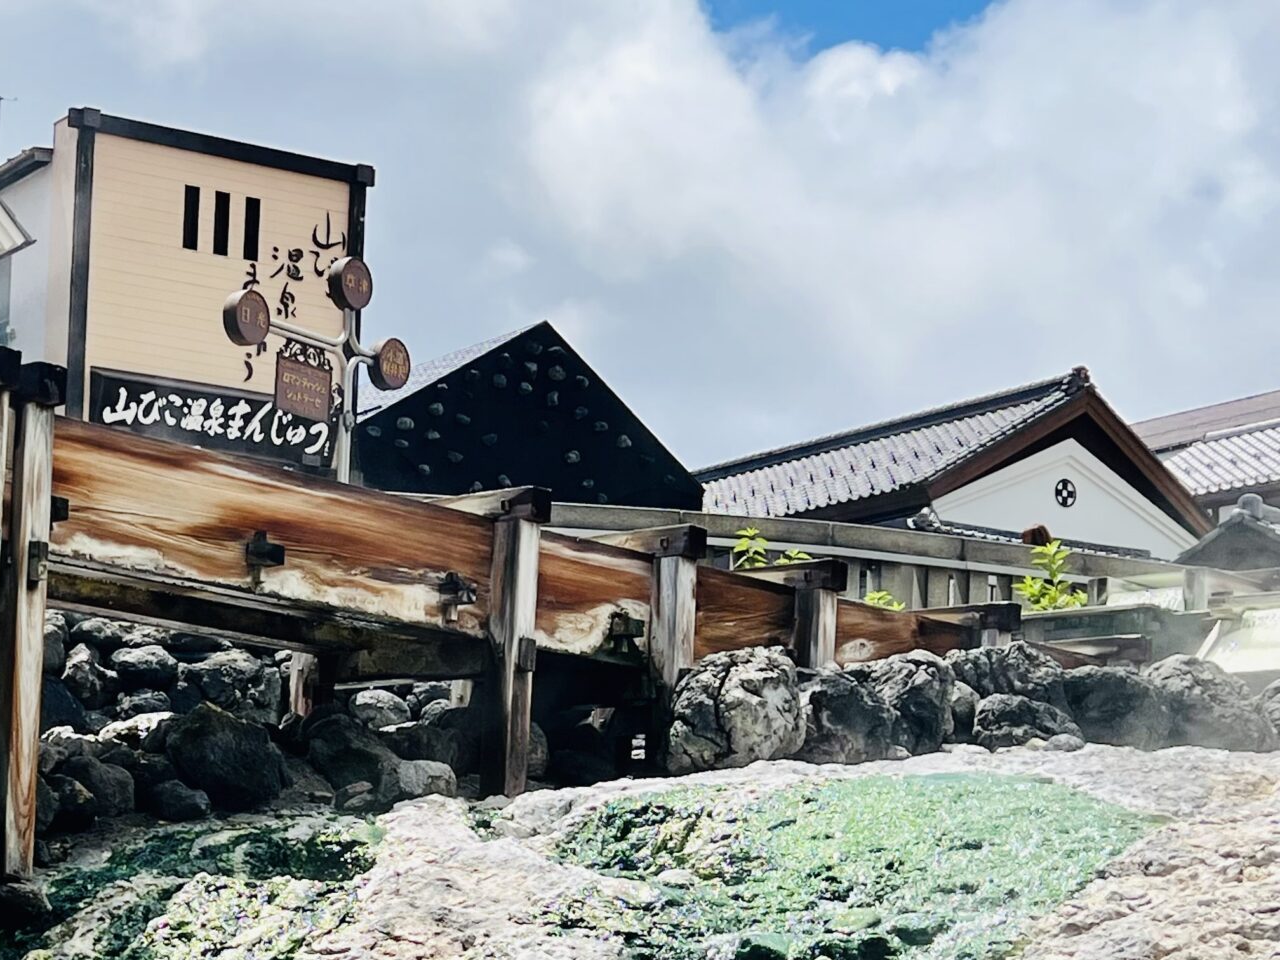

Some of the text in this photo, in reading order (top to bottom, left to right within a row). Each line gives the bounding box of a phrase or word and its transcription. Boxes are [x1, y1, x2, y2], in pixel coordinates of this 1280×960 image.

[269, 245, 304, 319] 温泉
[309, 209, 347, 299] 山び
[241, 306, 267, 329] 日光
